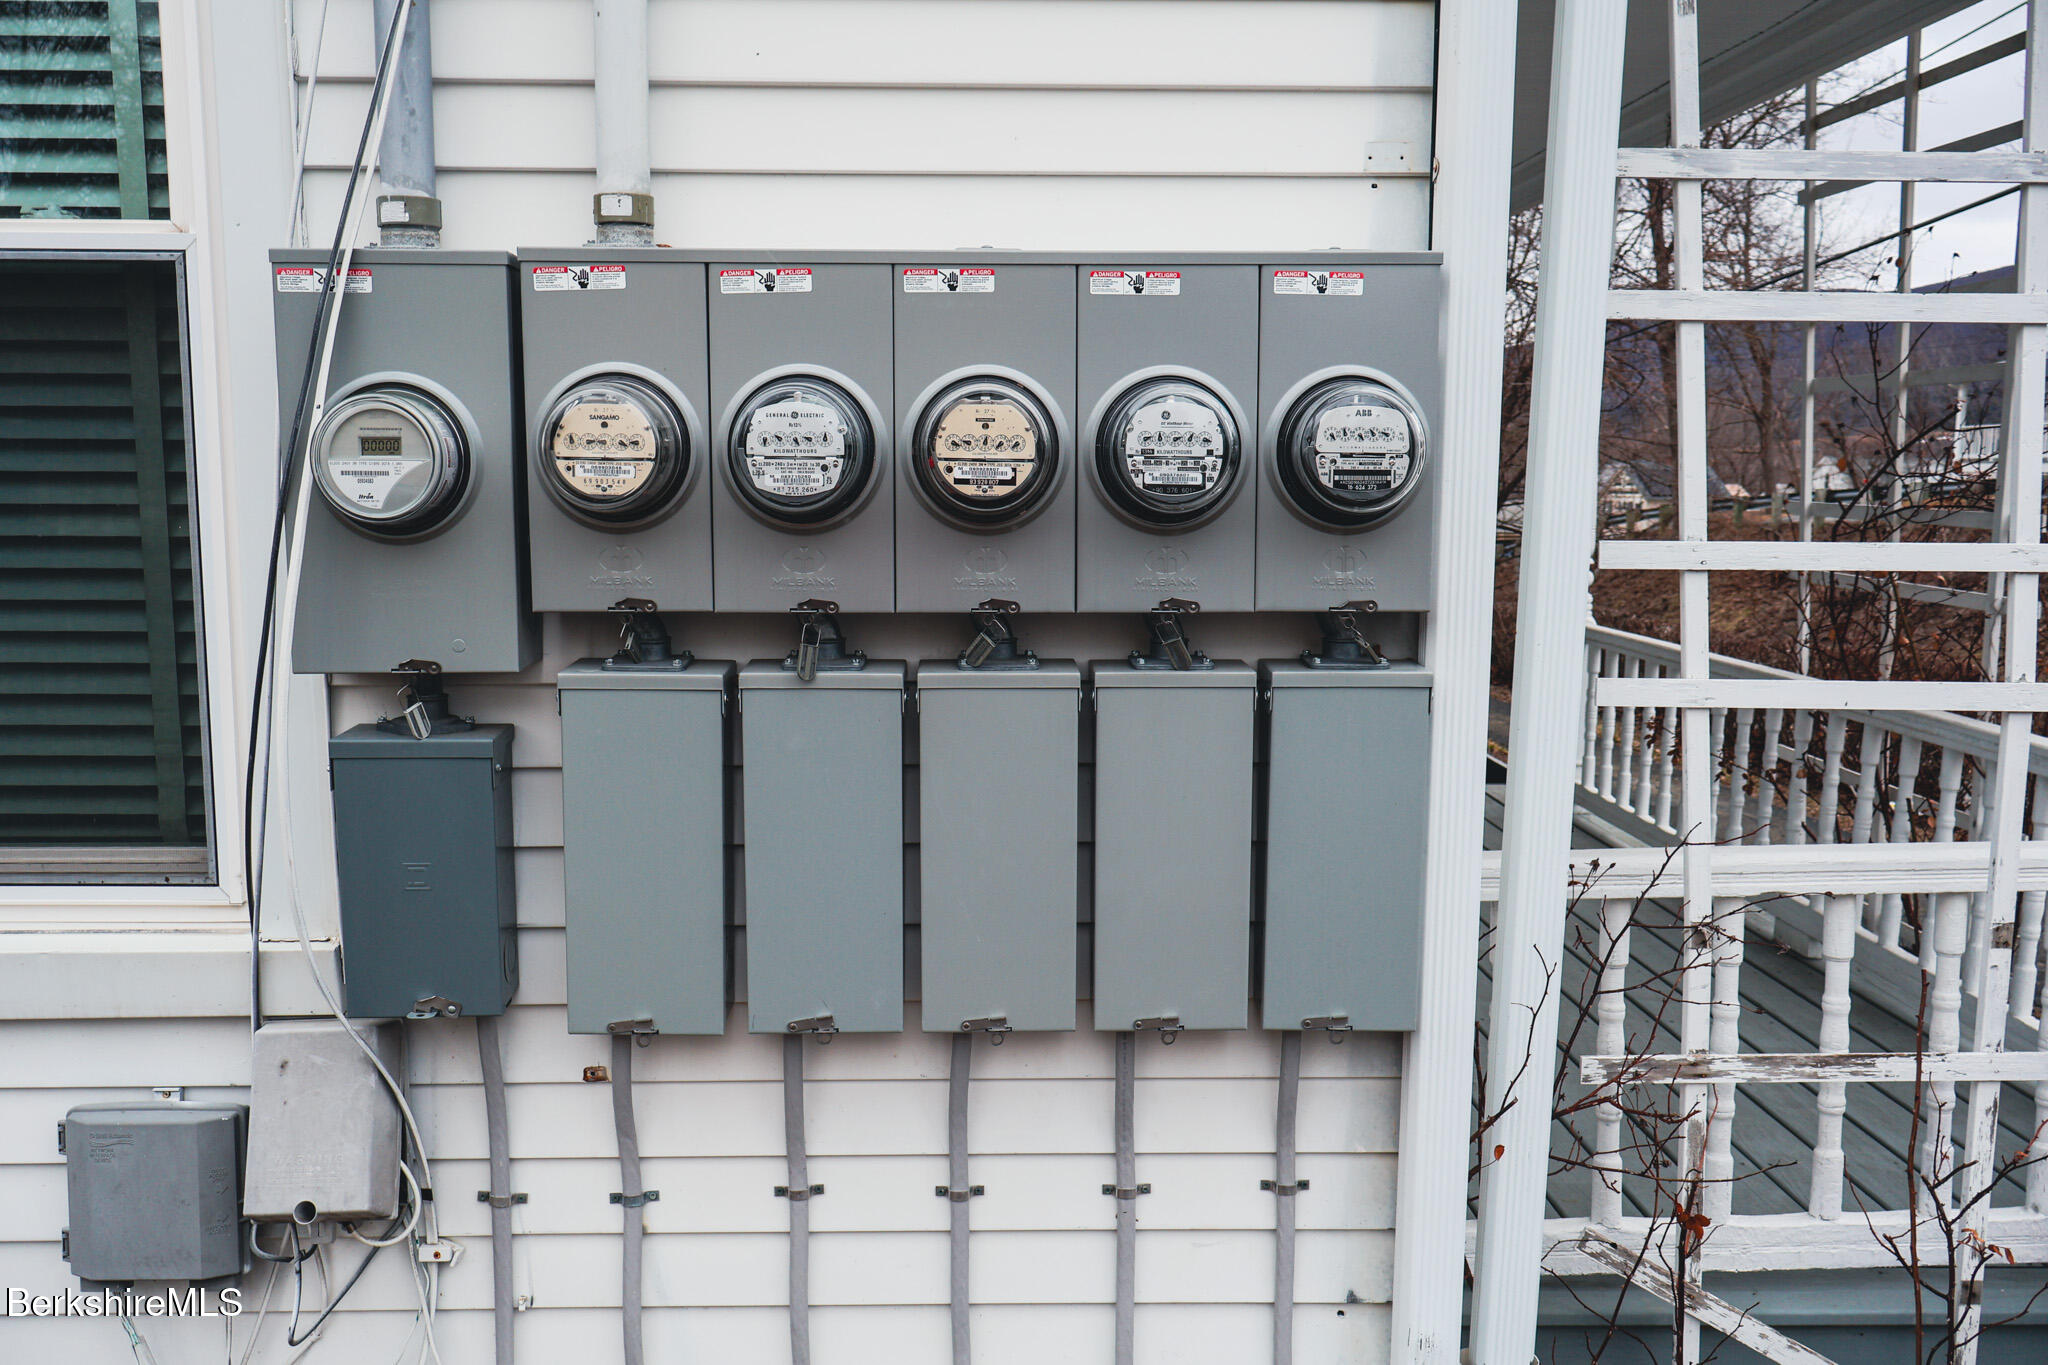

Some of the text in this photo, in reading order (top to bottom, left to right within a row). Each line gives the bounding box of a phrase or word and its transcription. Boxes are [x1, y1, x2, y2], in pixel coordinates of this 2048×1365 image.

[364, 440, 400, 452] 00000
[589, 576, 656, 585] MILBANK
[772, 576, 836, 586] MILBANK
[953, 576, 1017, 586] MILBANK
[1135, 576, 1197, 586] MILBANK
[1312, 576, 1376, 585] MILBANK
